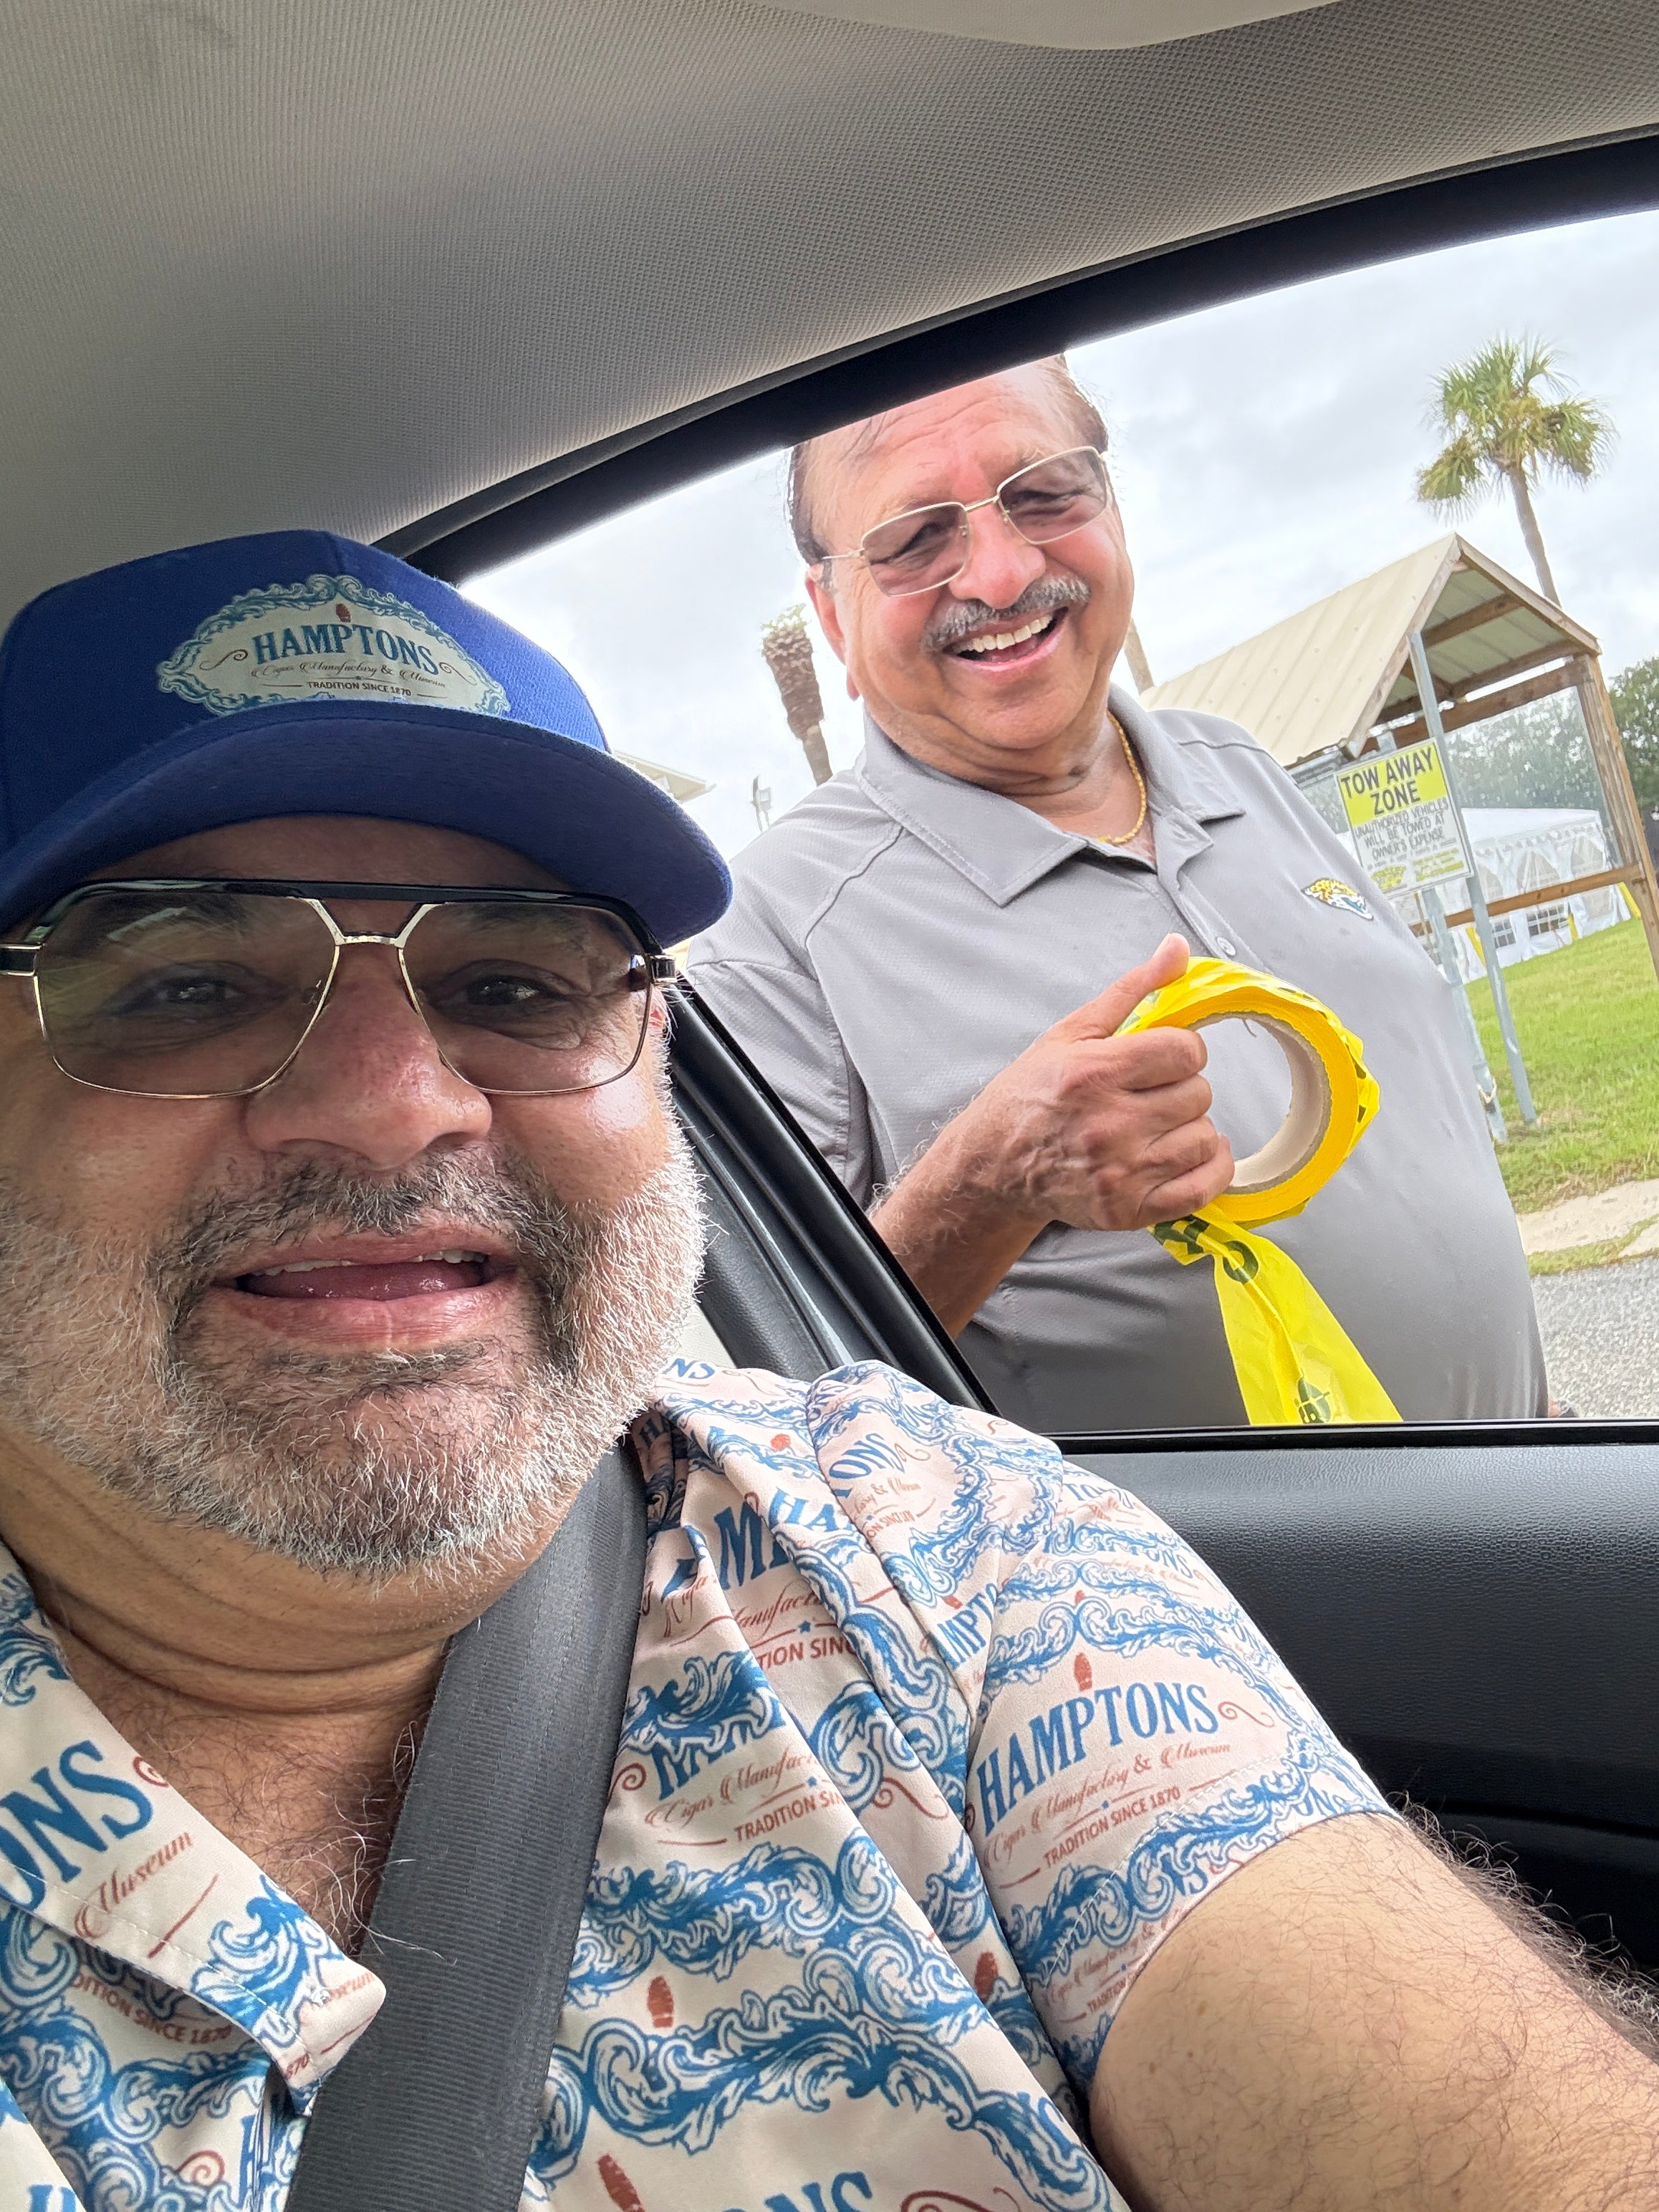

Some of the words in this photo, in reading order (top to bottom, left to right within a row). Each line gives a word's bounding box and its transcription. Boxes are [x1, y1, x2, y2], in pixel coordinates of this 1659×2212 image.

[252, 623, 439, 675] HAMPTONS
[308, 681, 360, 691] TRADITION
[361, 681, 388, 693] SINCE
[390, 686, 411, 697] 1870
[1340, 766, 1380, 799] TOW
[1385, 746, 1433, 784] AWAY
[1370, 780, 1421, 816] ZONE
[1364, 831, 1385, 848] WILL
[1402, 816, 1432, 836] TOWED
[1435, 809, 1445, 825] AT
[976, 1681, 1218, 1837] HAMPTONS
[1134, 1754, 1151, 1774] &
[734, 1794, 816, 1842] TRADITION
[1043, 1817, 1110, 1867] TRADITION
[1110, 1795, 1148, 1827] SINCE
[1150, 1785, 1181, 1808] 1870
[74, 1832, 194, 1939] Museum
